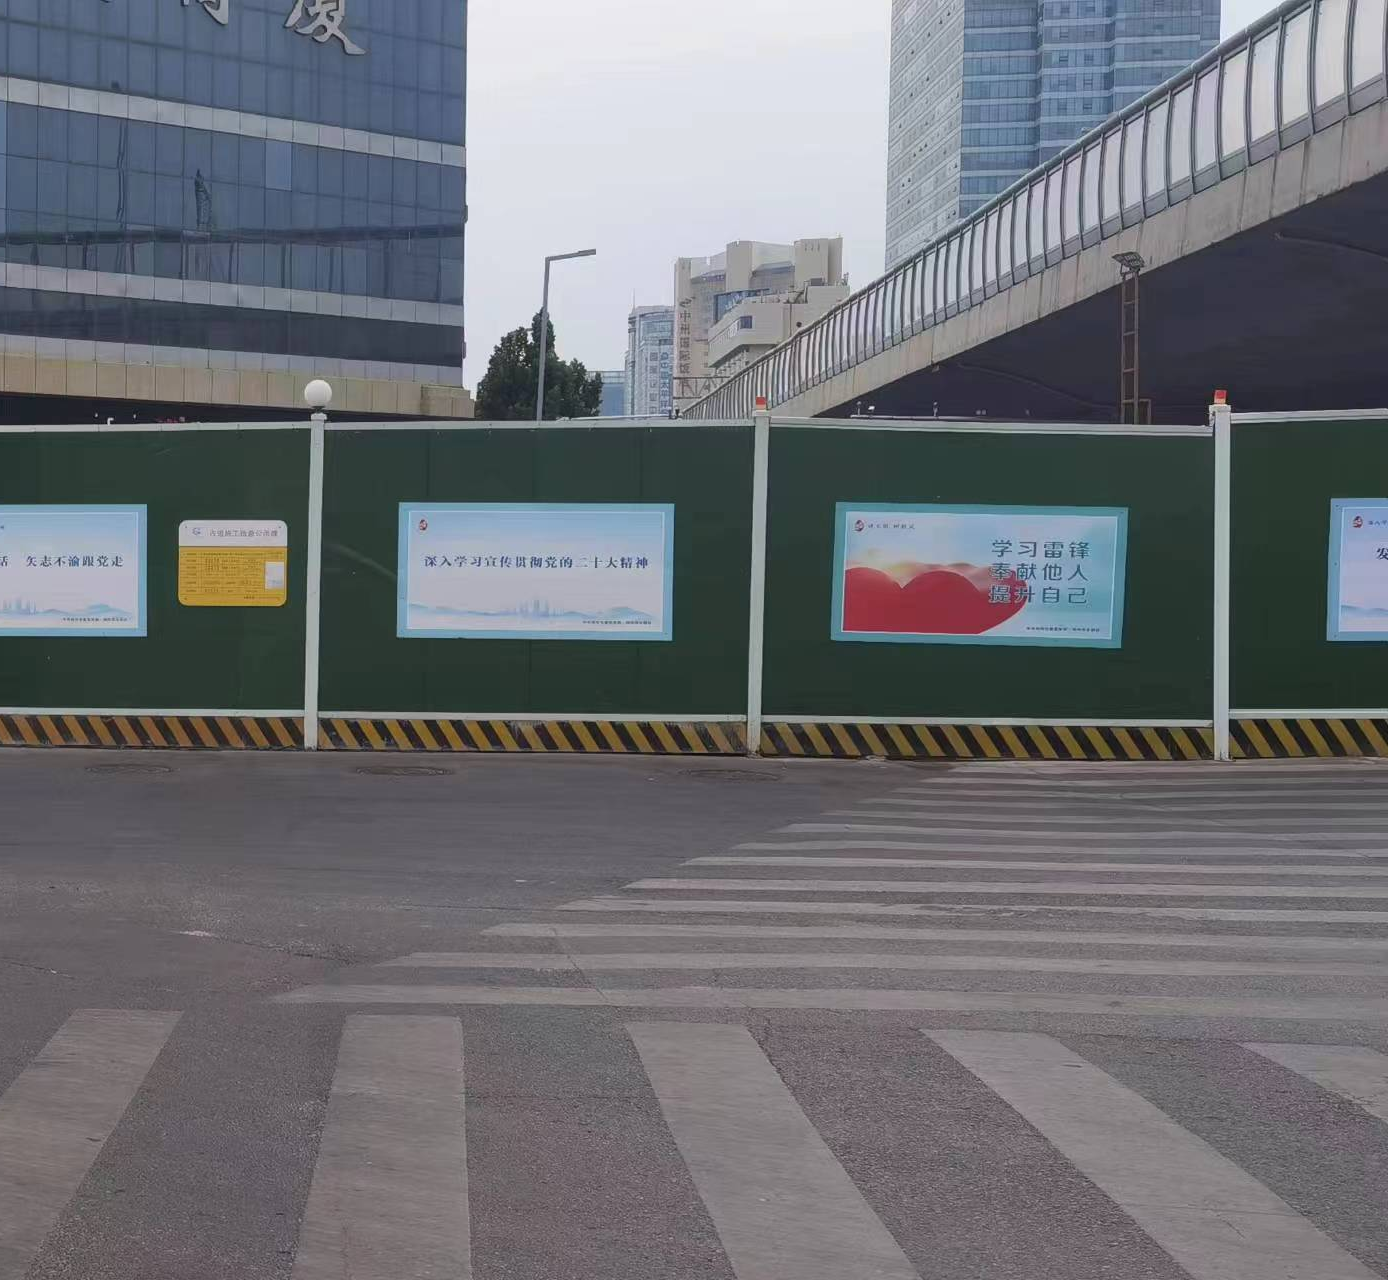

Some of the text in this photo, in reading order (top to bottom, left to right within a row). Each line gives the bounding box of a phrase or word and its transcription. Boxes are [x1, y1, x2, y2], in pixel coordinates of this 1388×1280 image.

[991, 539, 1090, 559] 学习雷锋
[423, 555, 649, 569] 深入学习宣传贯彻党的二十大精神
[989, 562, 1089, 581] 奉献他人
[988, 586, 1088, 604] 提升自己
